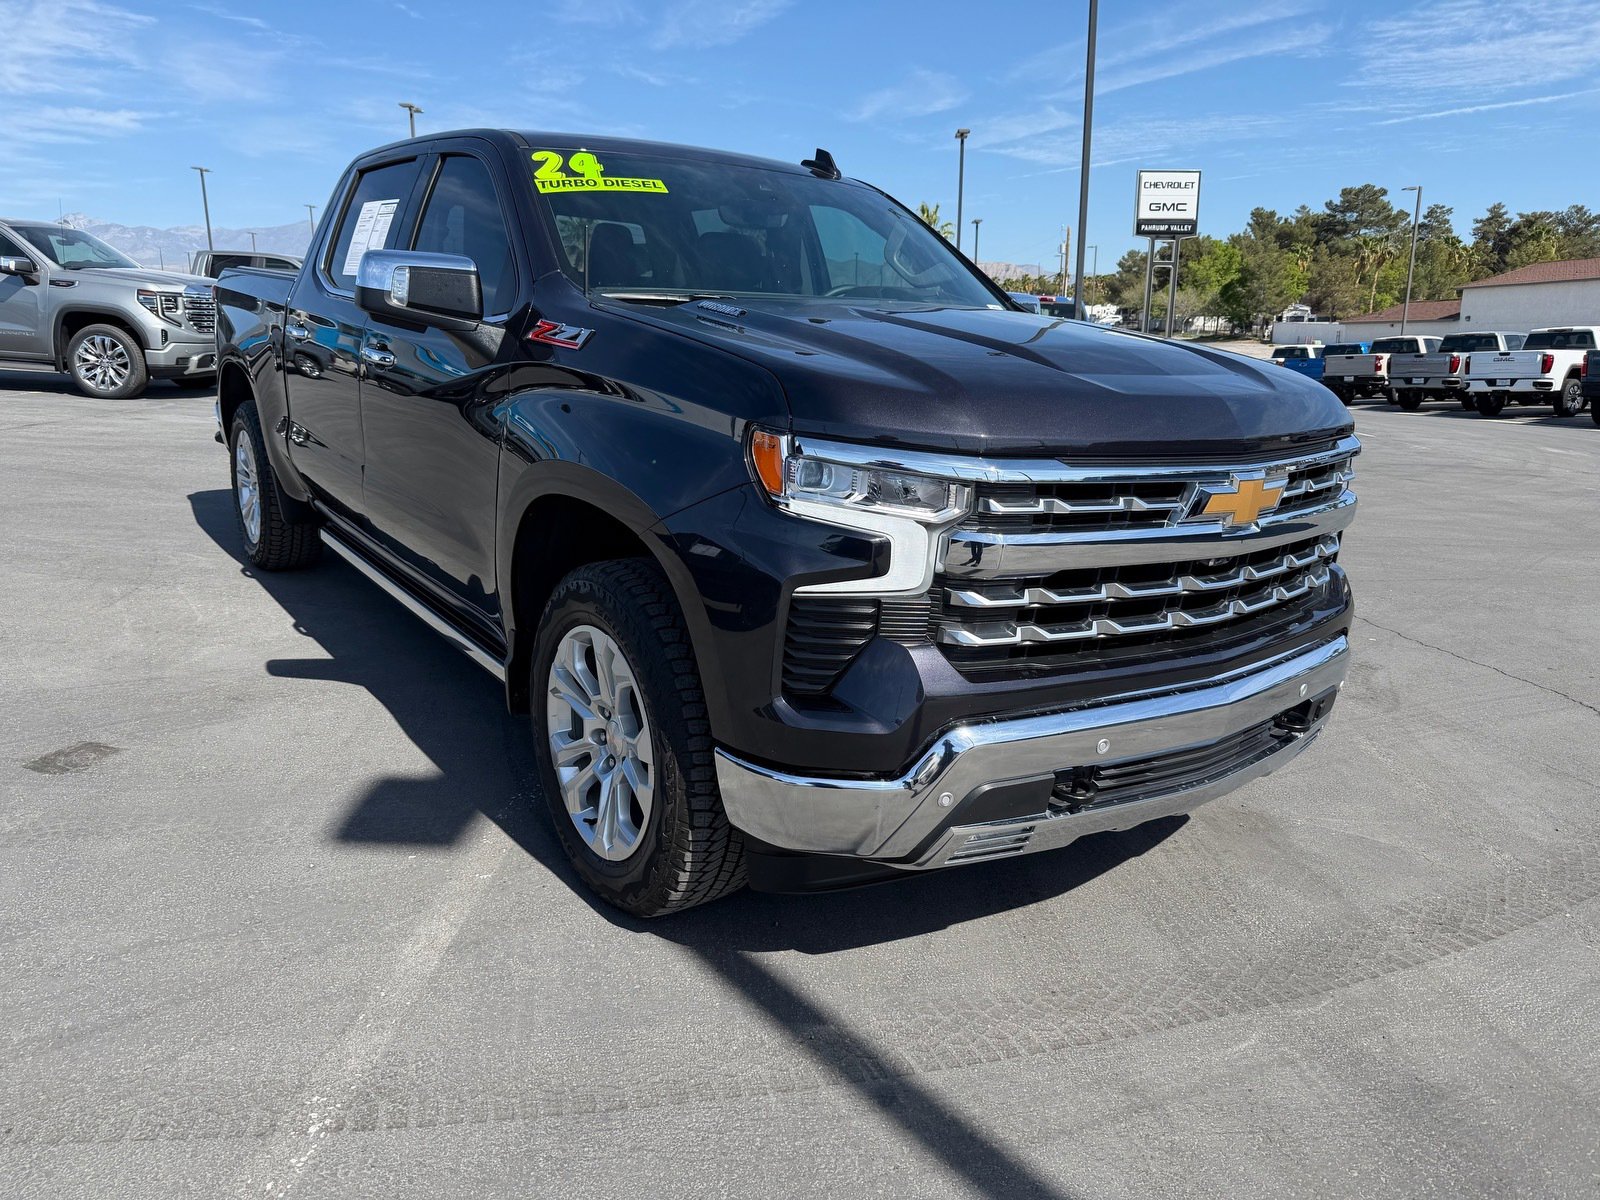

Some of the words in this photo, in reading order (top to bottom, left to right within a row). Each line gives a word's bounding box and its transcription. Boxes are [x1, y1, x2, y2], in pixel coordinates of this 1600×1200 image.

[531, 151, 604, 179] 24
[537, 178, 598, 189] TURBO
[603, 178, 663, 189] DIESEL
[1144, 181, 1195, 189] CHEVROLET
[1149, 203, 1187, 211] GMC
